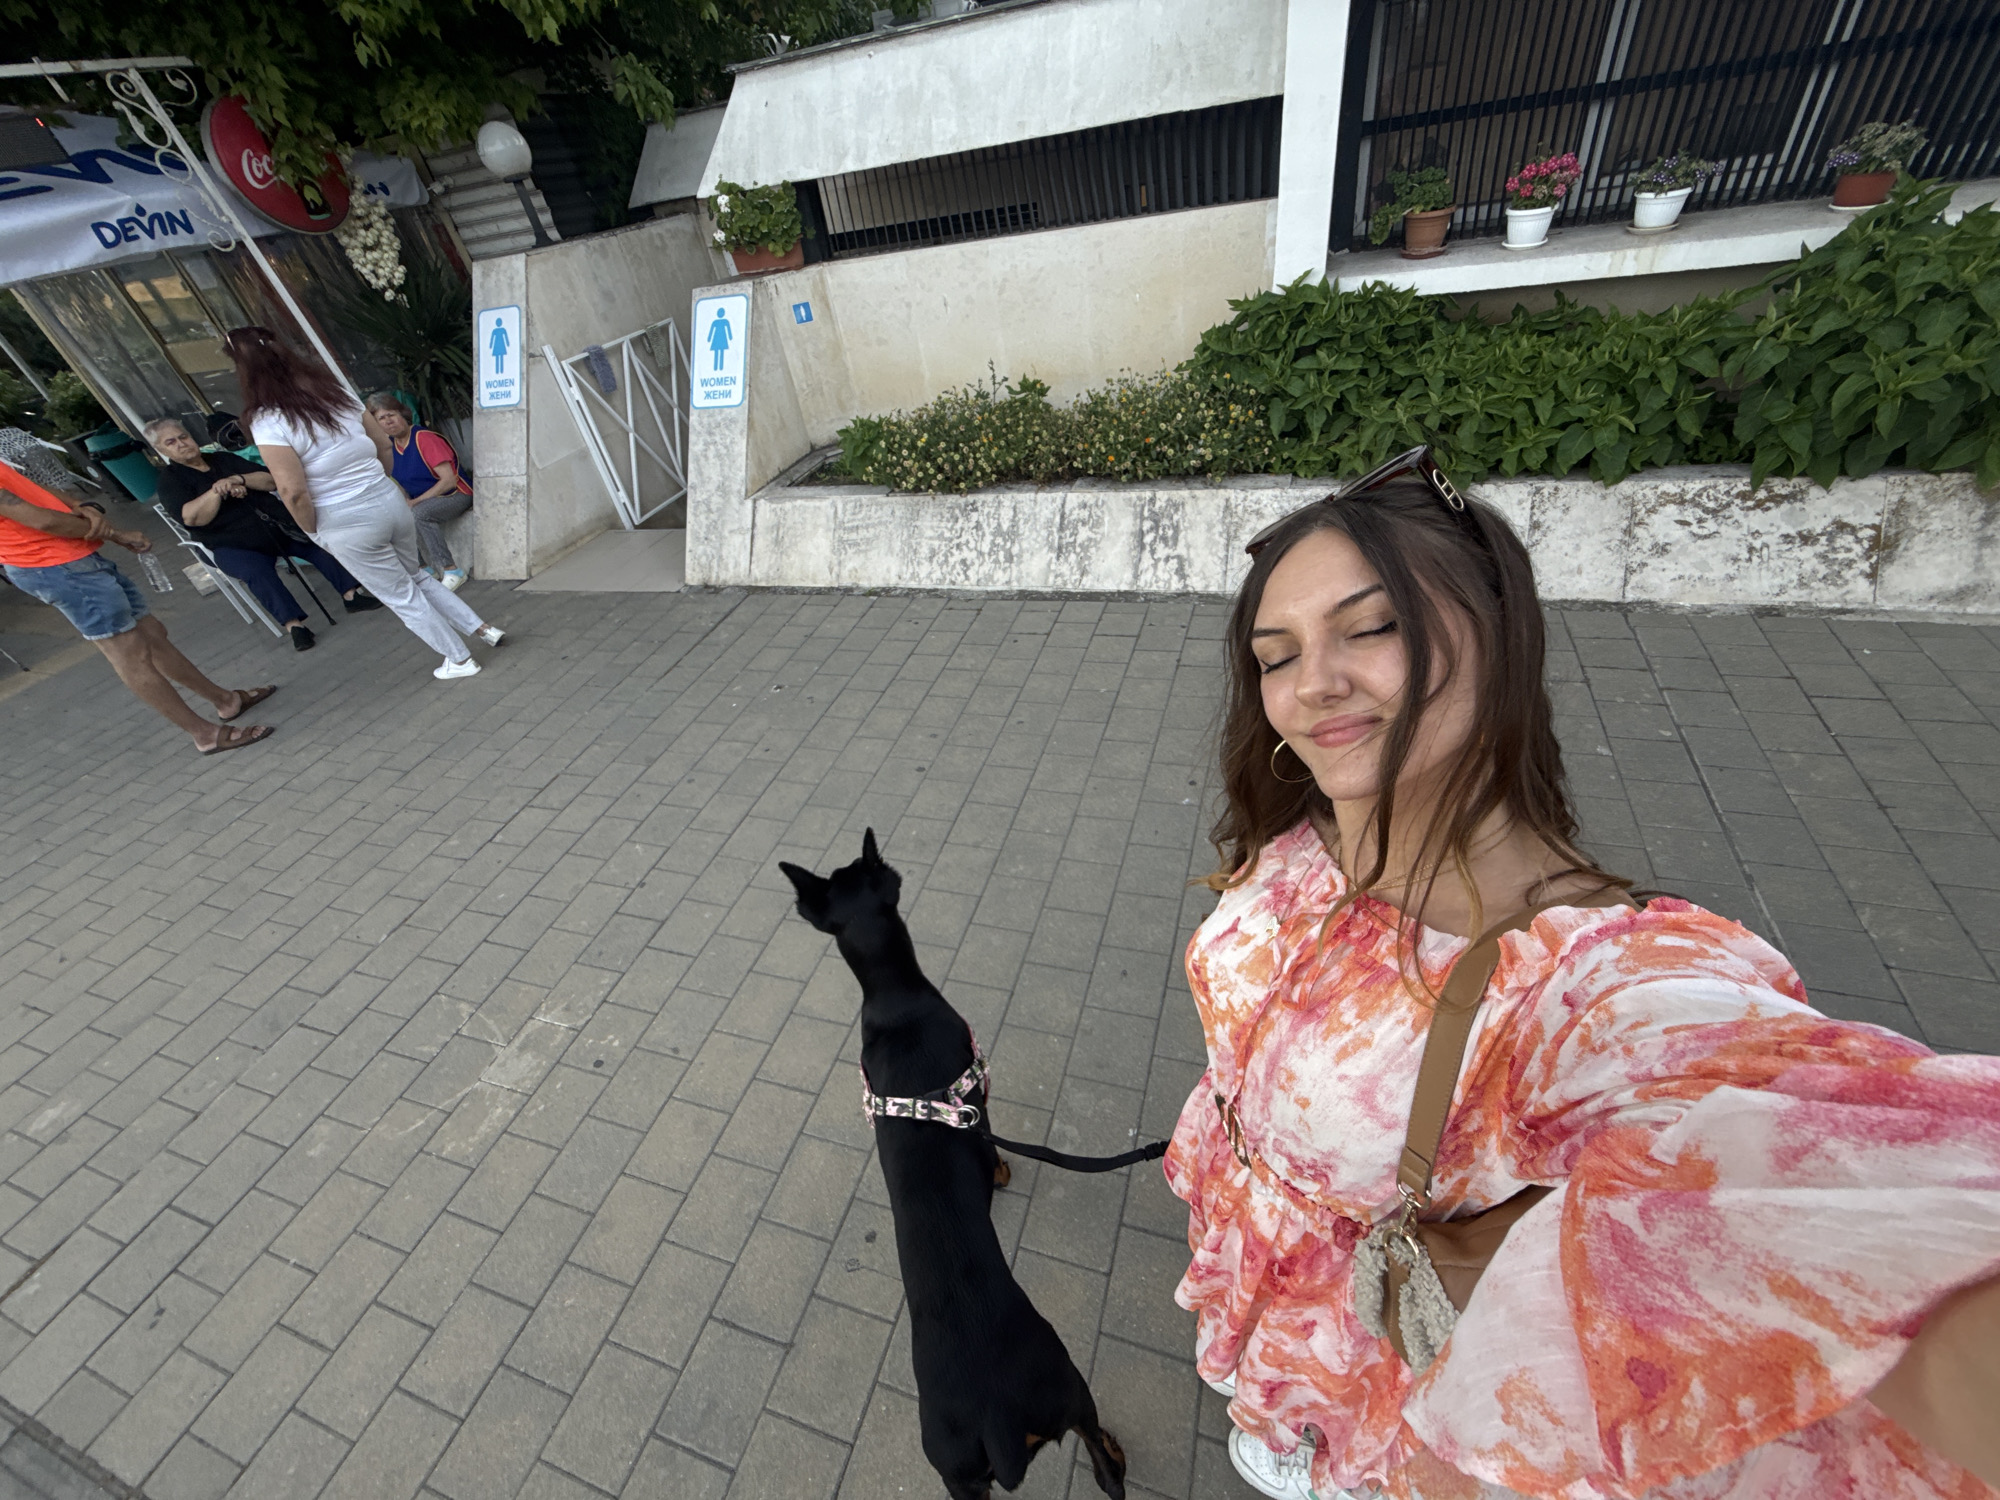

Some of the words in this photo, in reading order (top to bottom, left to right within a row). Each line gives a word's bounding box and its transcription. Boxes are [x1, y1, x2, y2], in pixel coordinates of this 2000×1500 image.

[241, 148, 277, 190] Coc
[91, 207, 194, 249] DEVIN
[485, 378, 515, 389] WOMEN
[700, 376, 736, 387] WOMEN
[489, 390, 511, 400] ЖЕНИ
[704, 389, 731, 400] ЖЕНИ
